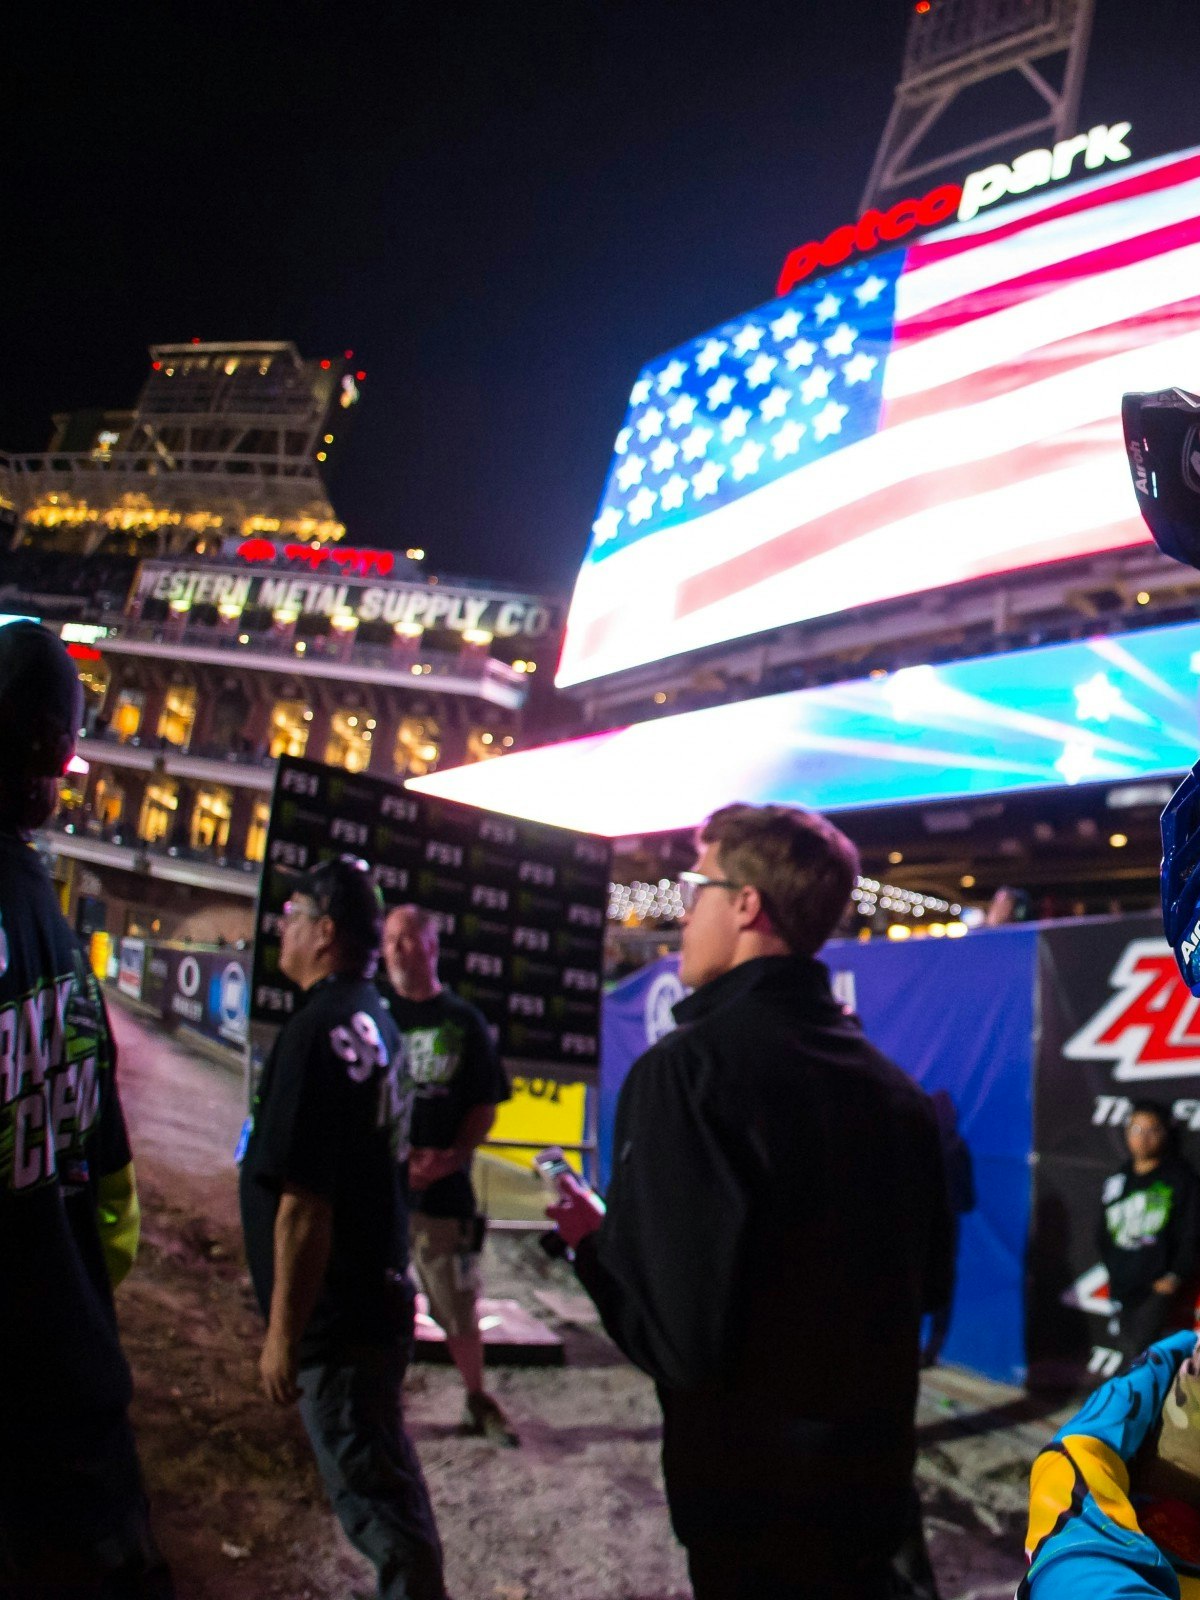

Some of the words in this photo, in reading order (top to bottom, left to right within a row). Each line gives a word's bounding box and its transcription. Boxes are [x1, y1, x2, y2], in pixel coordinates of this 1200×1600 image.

[140, 568, 252, 606] WESTERN
[257, 576, 352, 616] METAL
[358, 588, 491, 632] SUPPLY
